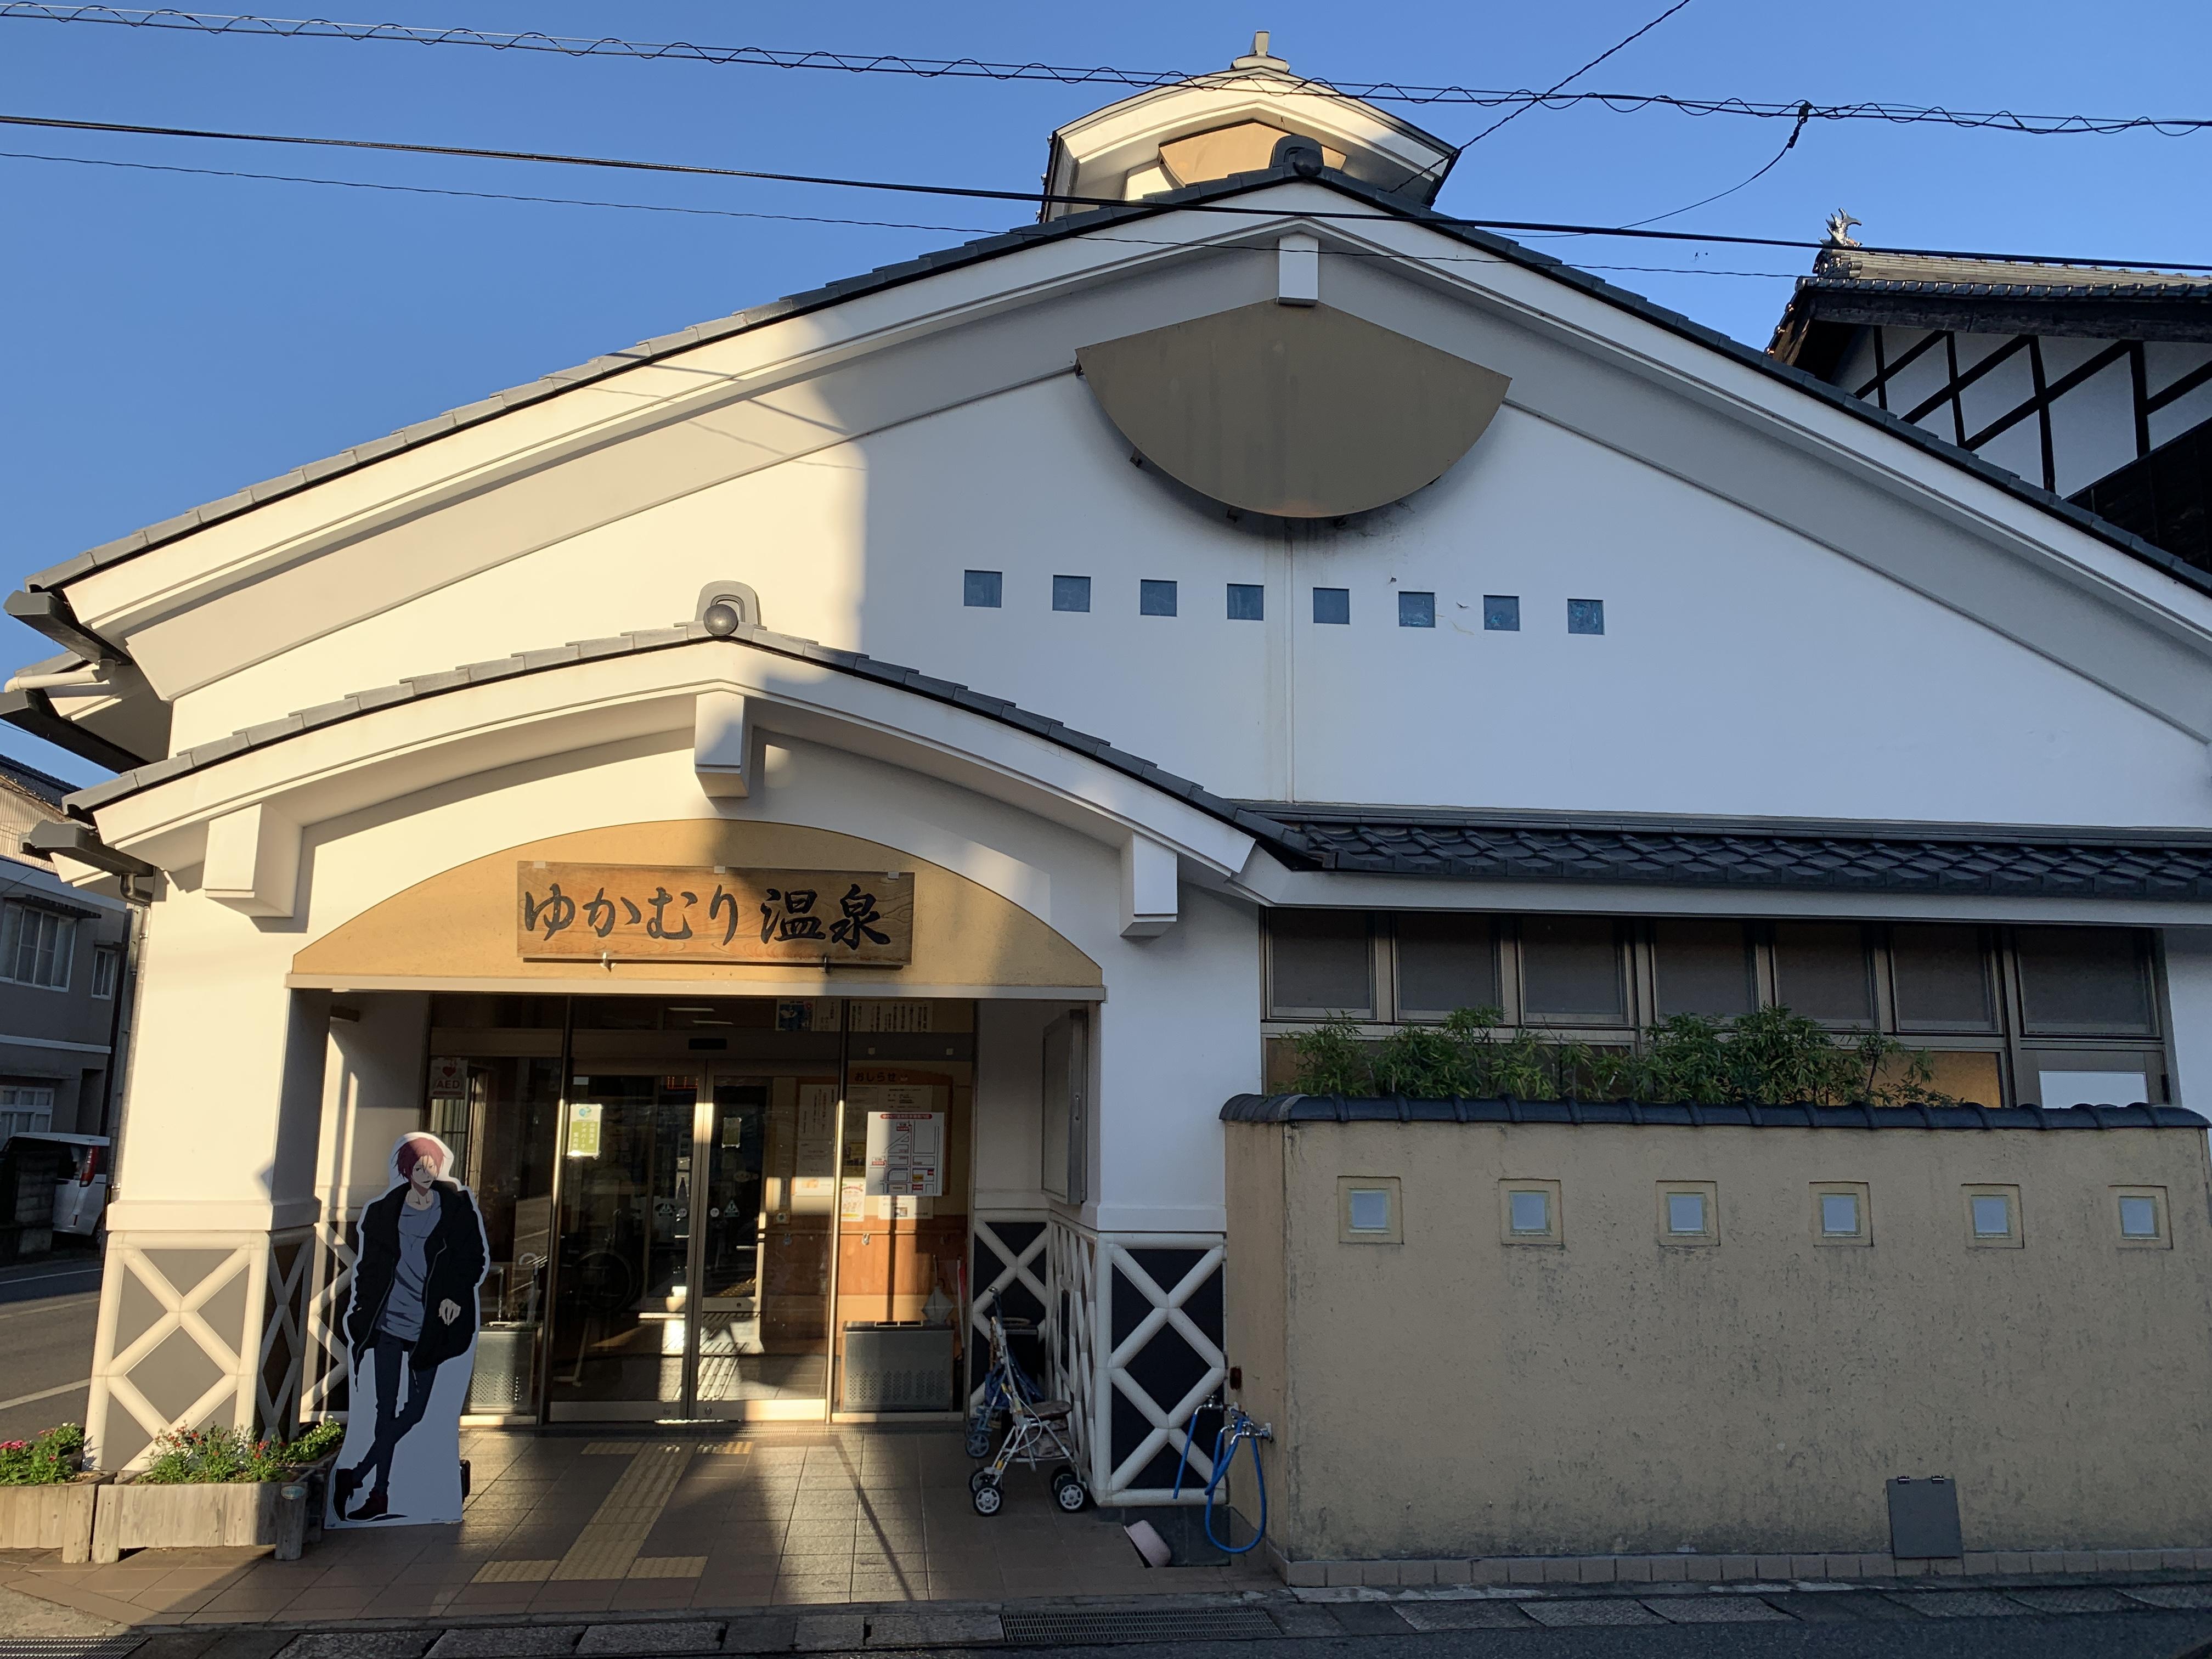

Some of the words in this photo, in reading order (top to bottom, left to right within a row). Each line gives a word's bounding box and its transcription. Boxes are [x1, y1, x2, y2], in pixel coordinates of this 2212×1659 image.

[524, 883, 891, 950] ゆかむり温泉
[855, 1071, 896, 1082] おしらせ
[437, 1080, 460, 1089] AED
